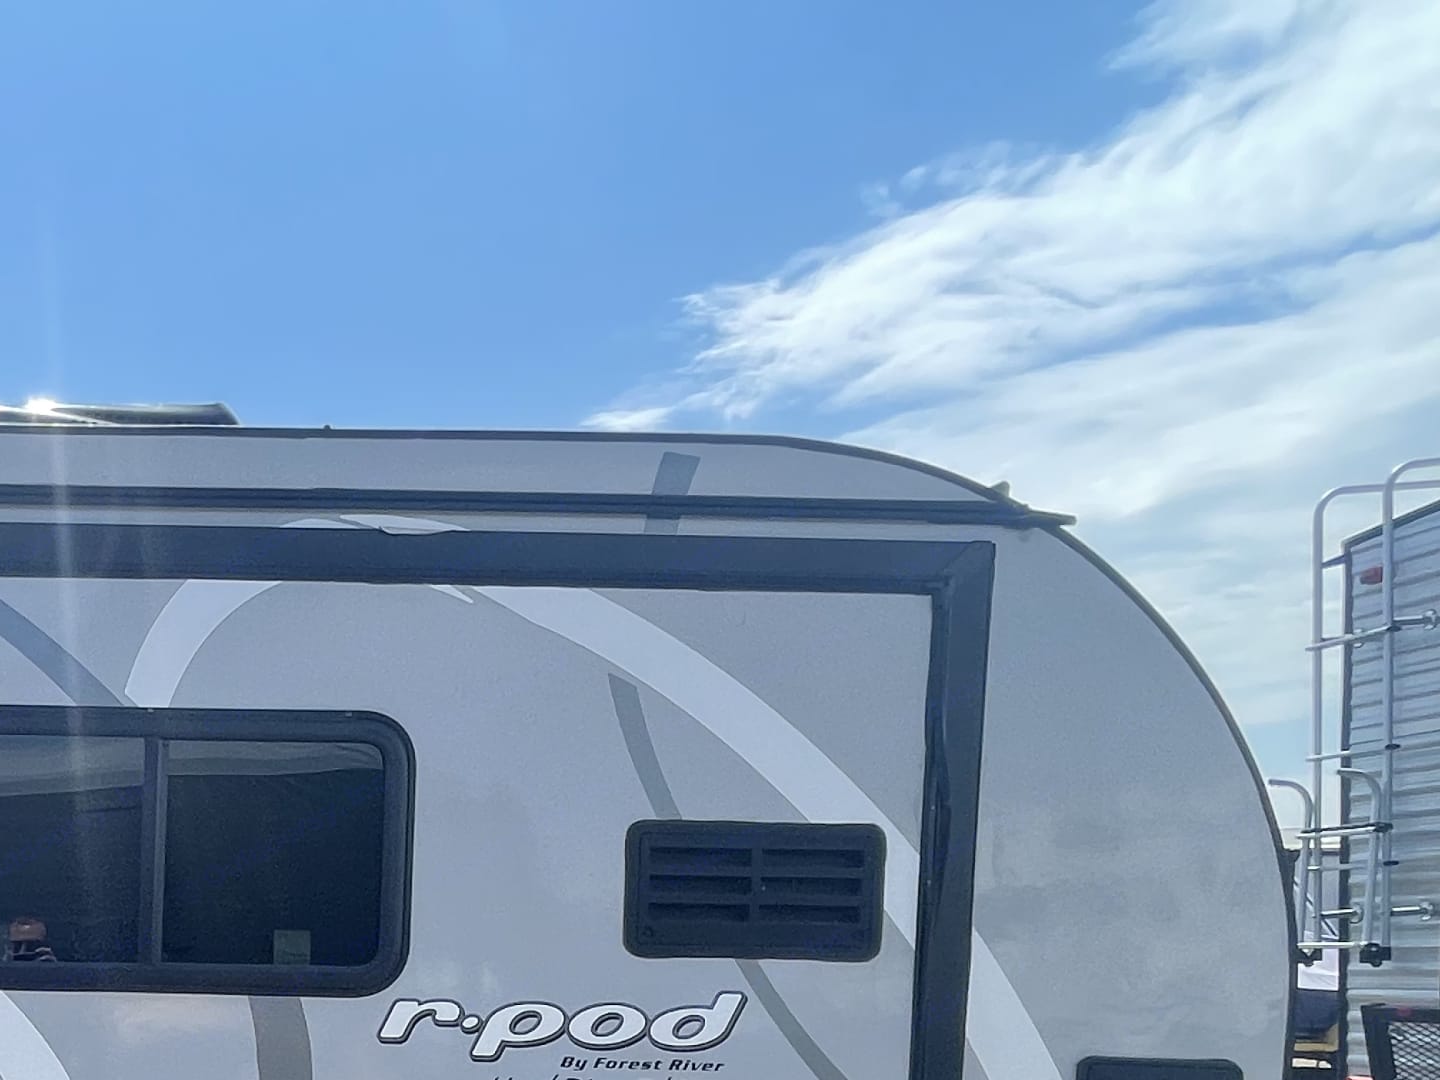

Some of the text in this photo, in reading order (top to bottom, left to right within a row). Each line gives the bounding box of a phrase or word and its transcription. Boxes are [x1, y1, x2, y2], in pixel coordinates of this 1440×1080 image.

[560, 1056, 725, 1072] By Forest River
